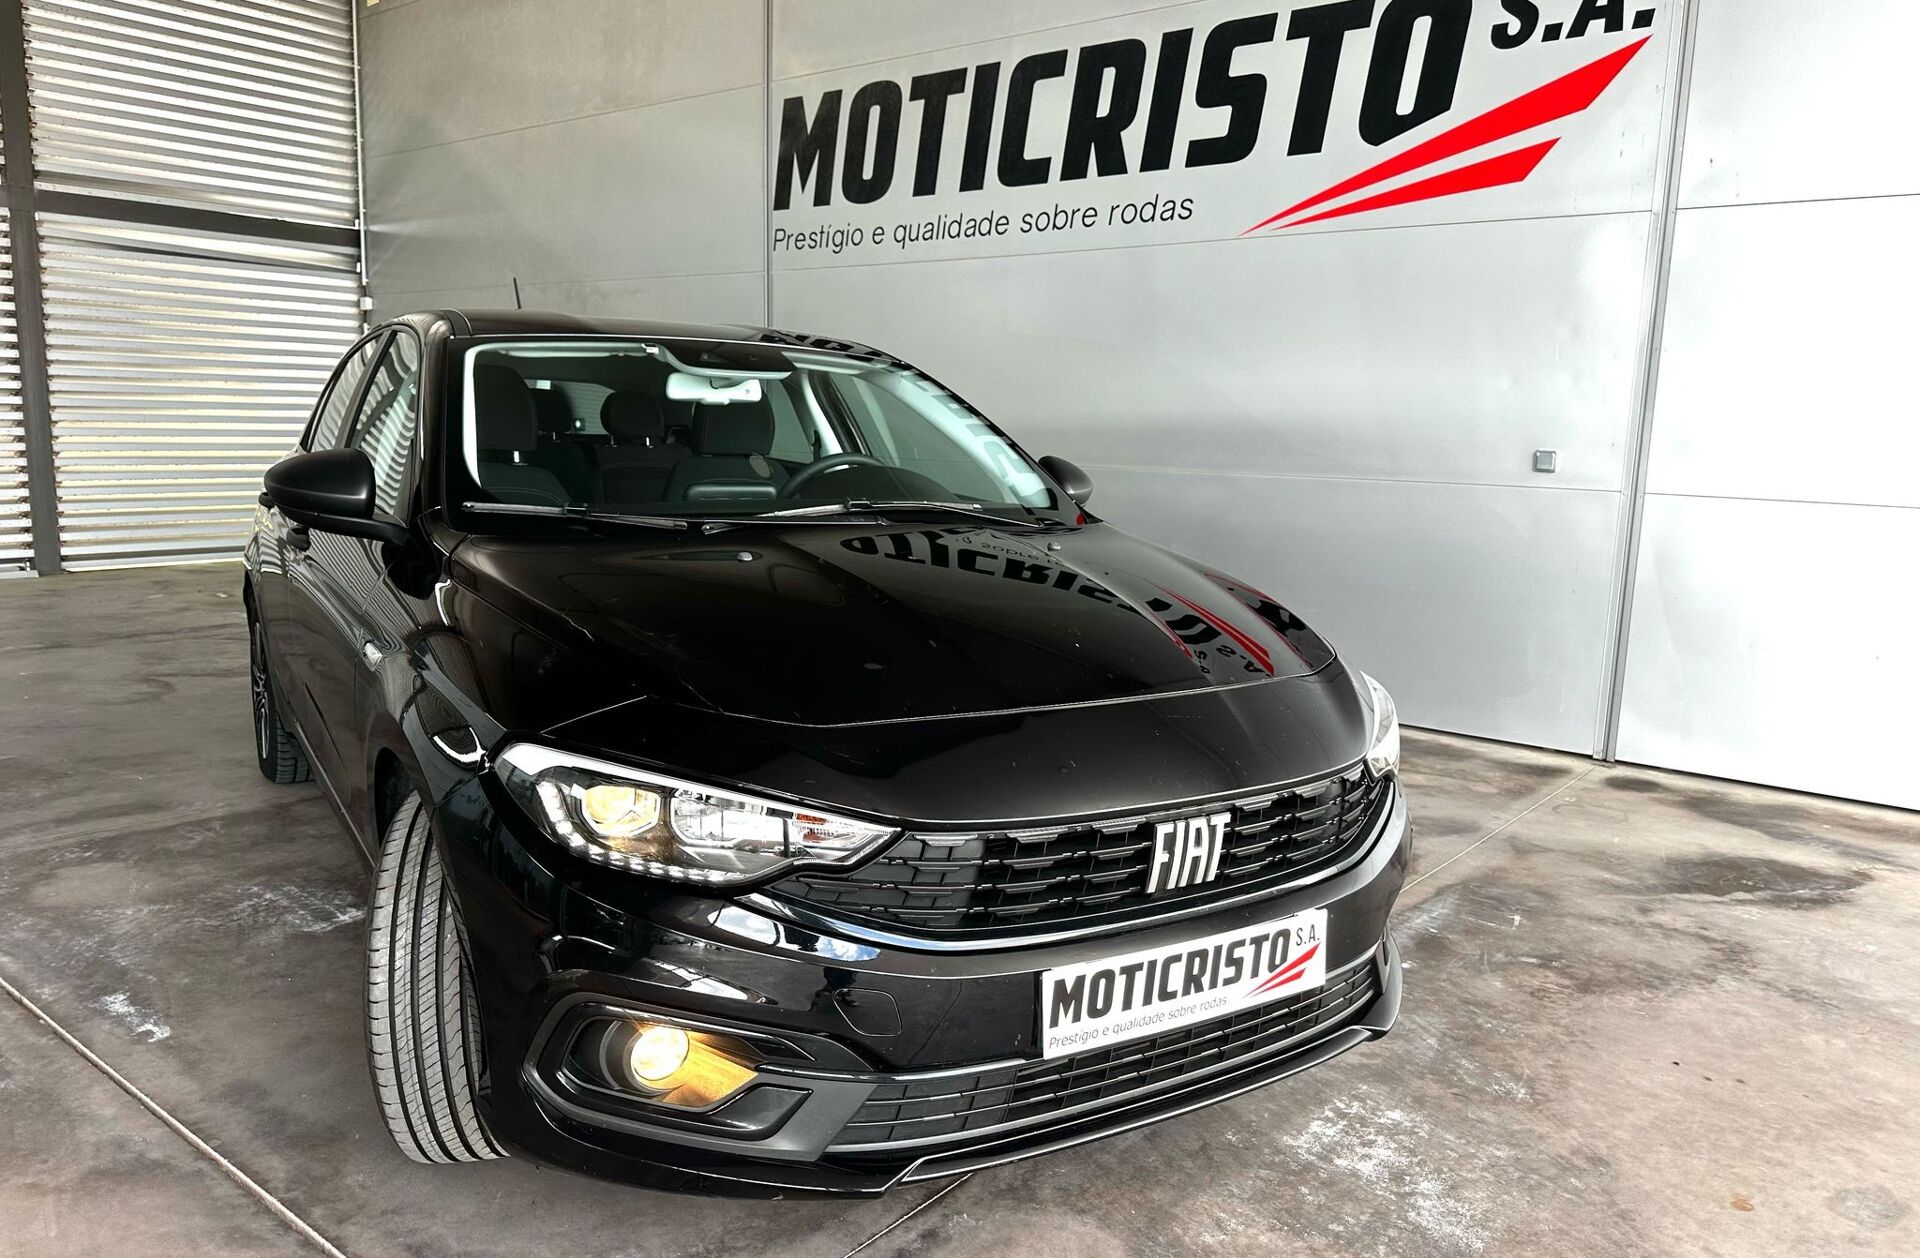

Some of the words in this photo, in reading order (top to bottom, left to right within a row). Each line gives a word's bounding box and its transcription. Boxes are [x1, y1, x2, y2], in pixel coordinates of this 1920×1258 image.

[773, 0, 1473, 211] MOTICRISTO
[1491, 0, 1656, 49] S.A.
[773, 222, 863, 254] Prestígio
[871, 226, 885, 245] e
[893, 210, 1009, 249] qualidade
[1020, 202, 1098, 235] sobre
[1108, 194, 1194, 226] rodas
[1146, 812, 1231, 894] FIAT
[1049, 928, 1291, 1029] MOTICRISTO
[1296, 923, 1320, 946] S.A.
[1102, 1026, 1110, 1037] e
[1112, 1012, 1165, 1035] qualidade
[1168, 1003, 1197, 1020] sobre
